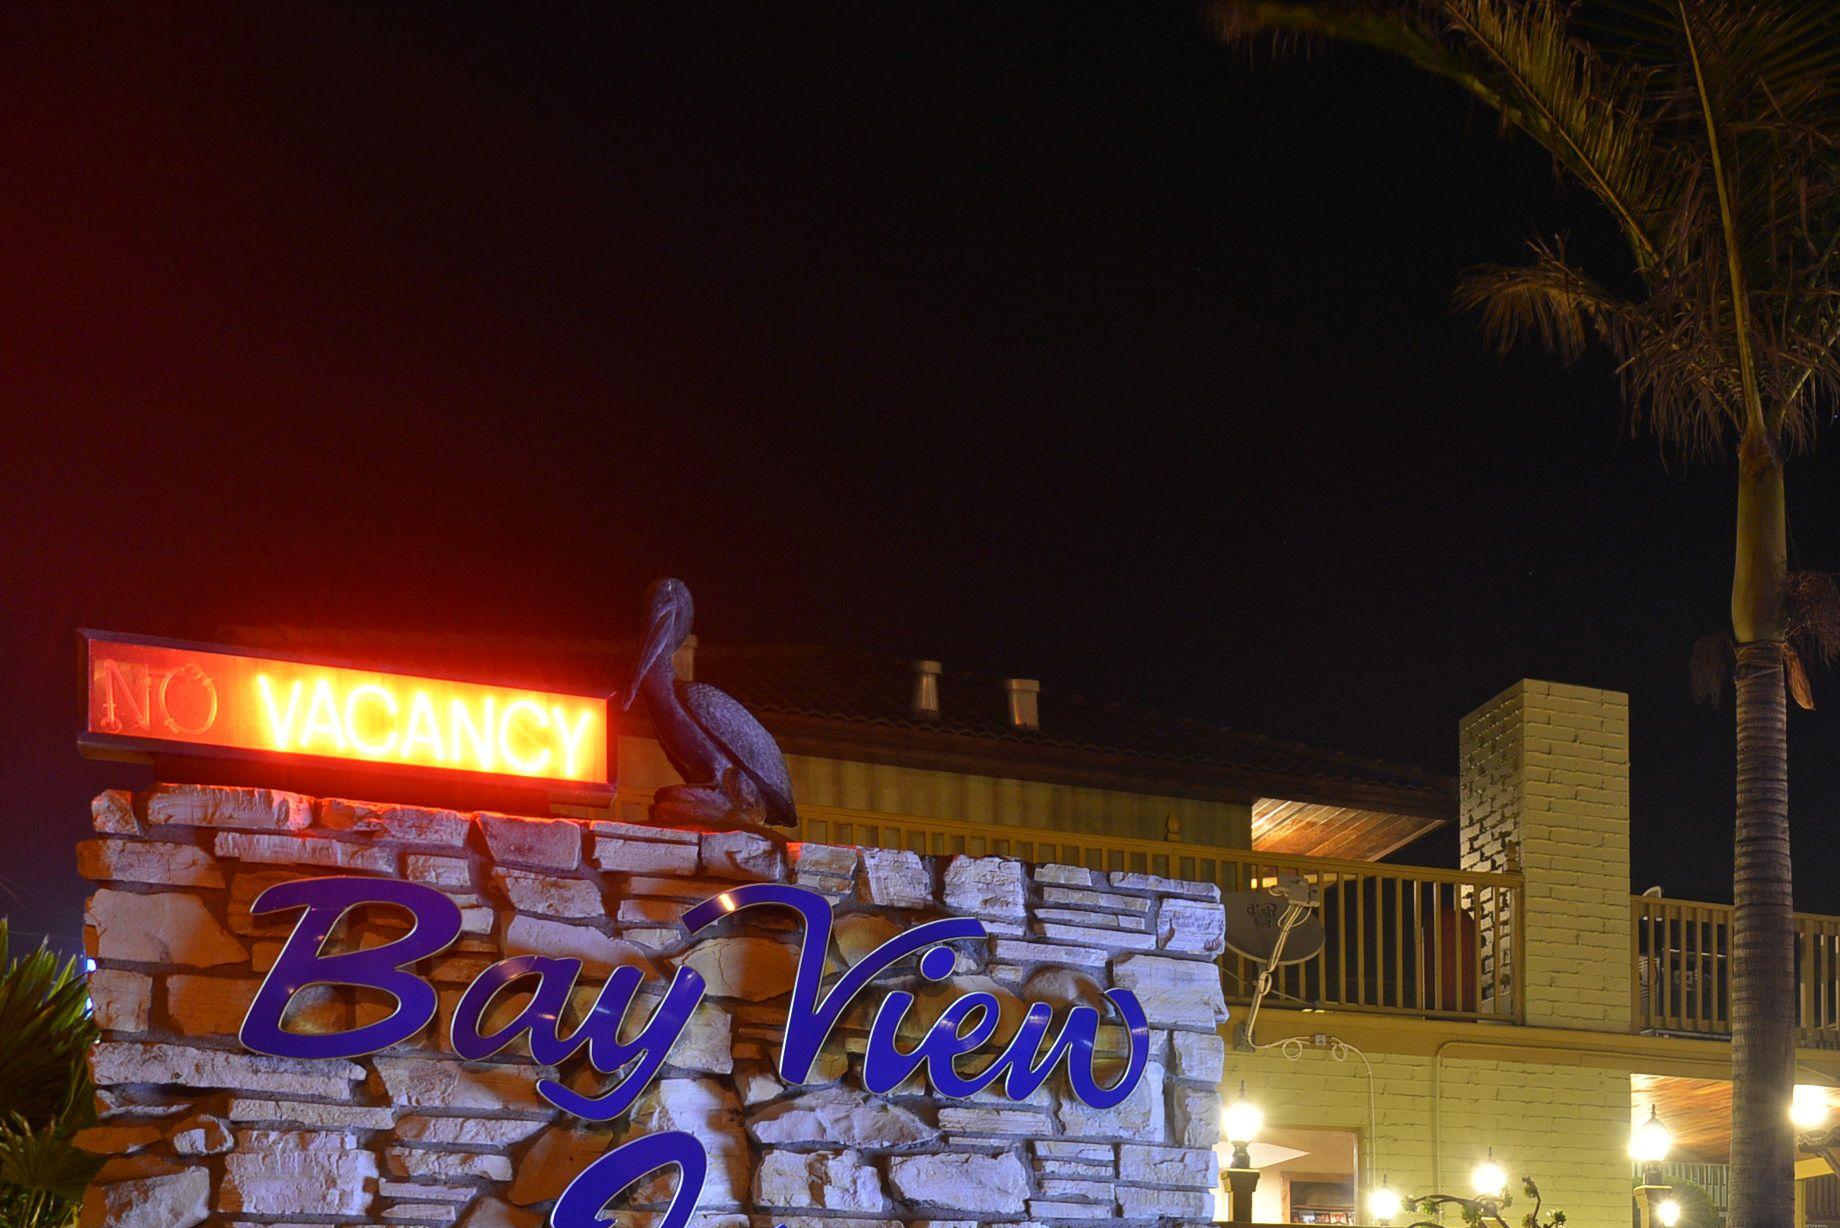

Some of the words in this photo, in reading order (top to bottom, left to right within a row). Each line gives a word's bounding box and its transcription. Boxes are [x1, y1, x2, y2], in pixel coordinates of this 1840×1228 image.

[101, 658, 218, 734] NO
[255, 673, 595, 777] VACANCY
[236, 874, 706, 1122] Bay
[681, 883, 1150, 1110] View
